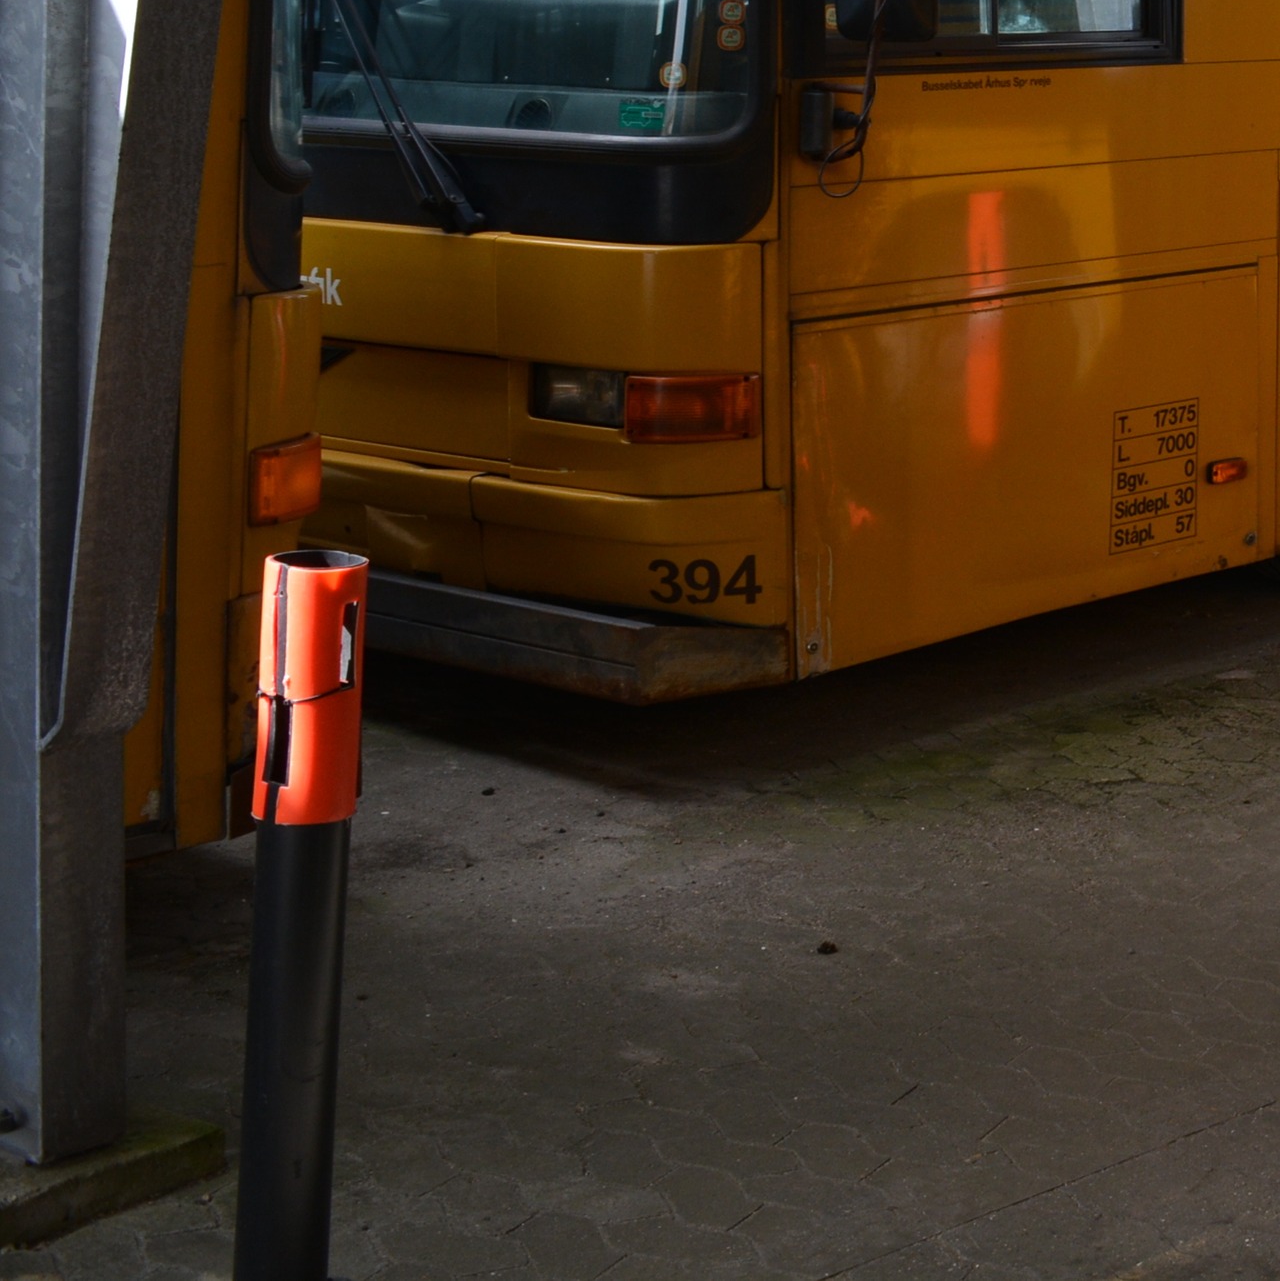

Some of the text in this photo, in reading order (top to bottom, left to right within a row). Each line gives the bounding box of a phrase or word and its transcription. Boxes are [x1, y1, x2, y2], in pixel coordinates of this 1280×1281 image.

[1117, 404, 1197, 434] T. 17375
[1117, 431, 1196, 463] L. 7000
[1116, 459, 1195, 492] Bgv. 0
[1114, 486, 1195, 520] Siddepl. 30
[1113, 513, 1194, 548] Ståpl. 57
[647, 554, 763, 605] 394
